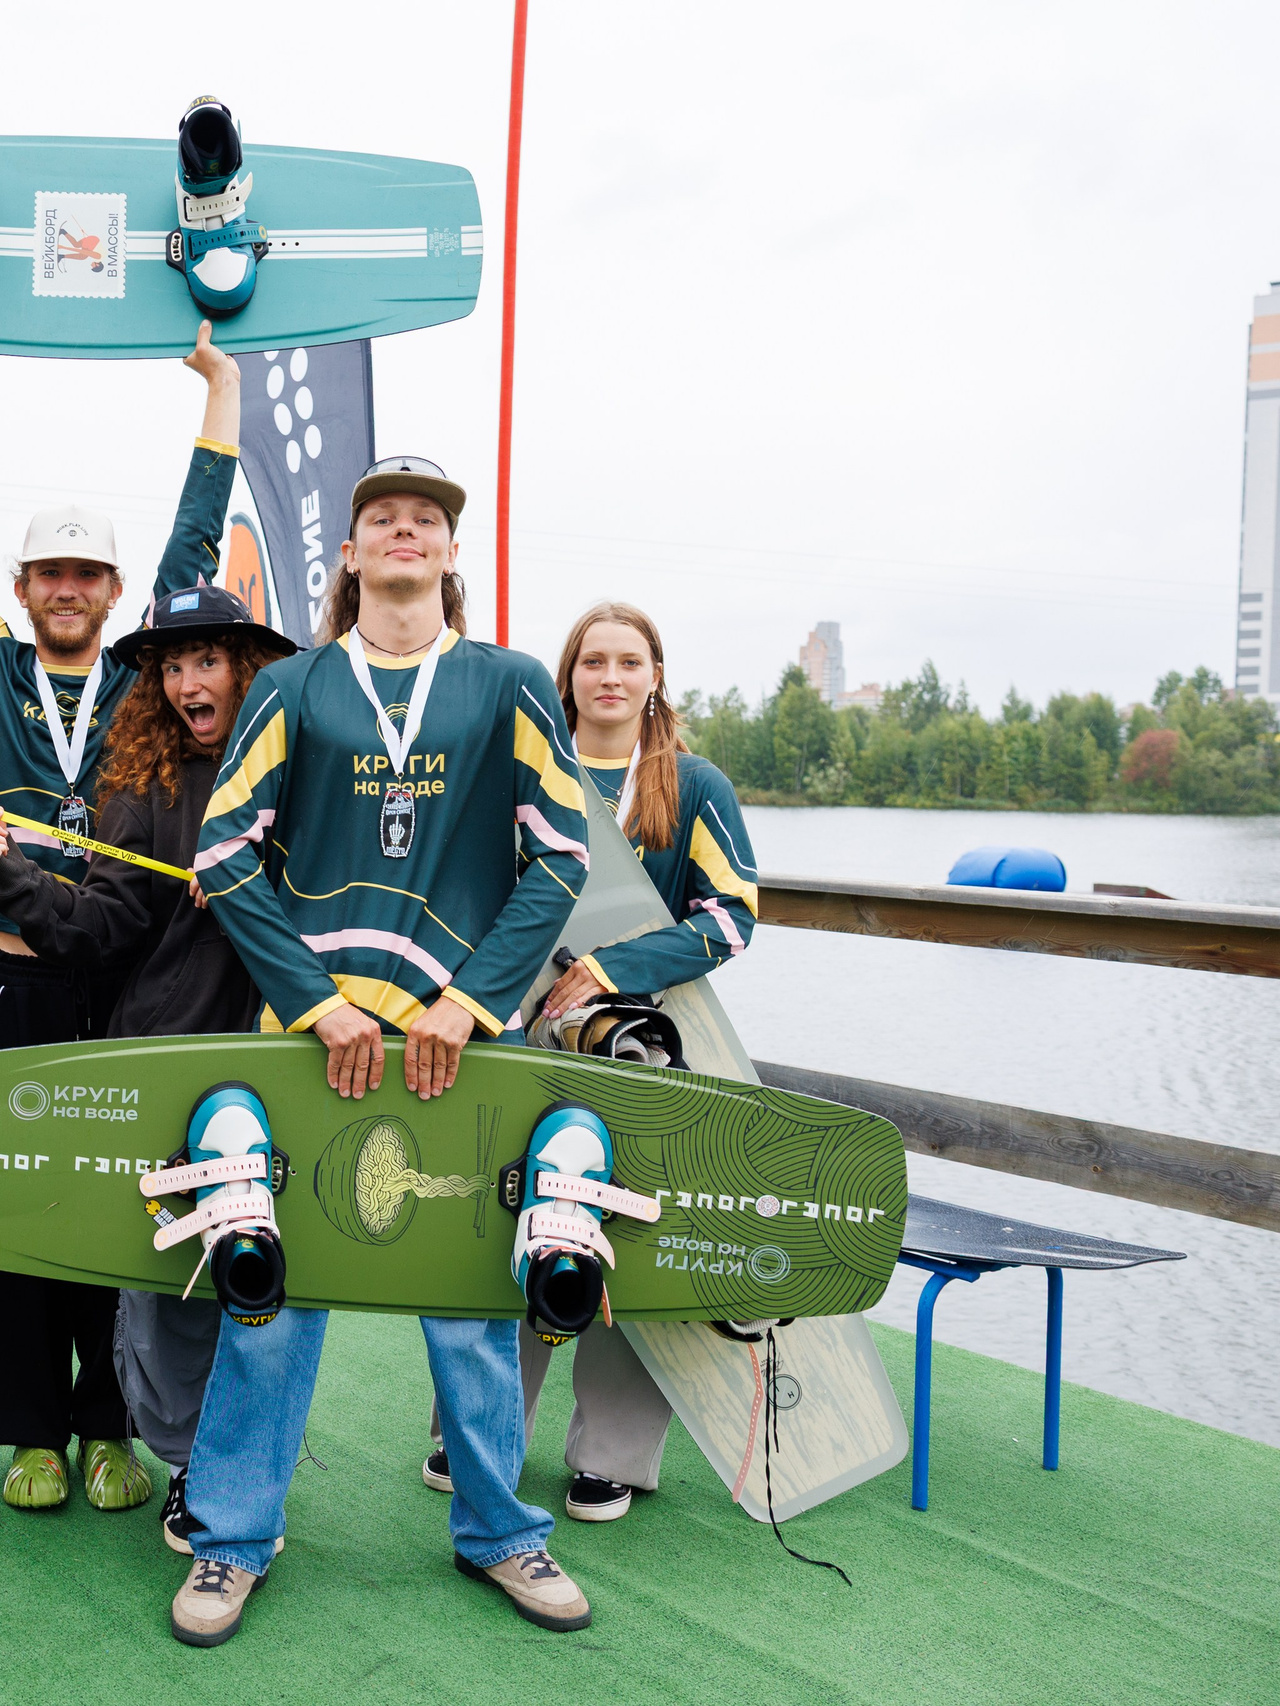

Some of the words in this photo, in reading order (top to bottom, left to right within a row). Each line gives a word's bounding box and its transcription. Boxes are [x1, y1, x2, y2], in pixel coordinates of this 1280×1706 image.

[42, 208, 57, 279] ВЕЙКБОРД
[107, 213, 118, 266] МАССЫ!
[107, 269, 117, 277] В
[353, 754, 445, 774] КРГИ
[354, 781, 380, 795] на
[78, 838, 94, 847] VIP
[121, 851, 137, 861] VIP
[54, 1085, 139, 1104] КРУГИ
[52, 1105, 80, 1118] на
[85, 1108, 138, 1122] воде
[658, 1235, 713, 1253] воде
[717, 1243, 746, 1256] на
[656, 1252, 743, 1277] КРУГИ
[232, 1313, 276, 1326] КРУГИ
